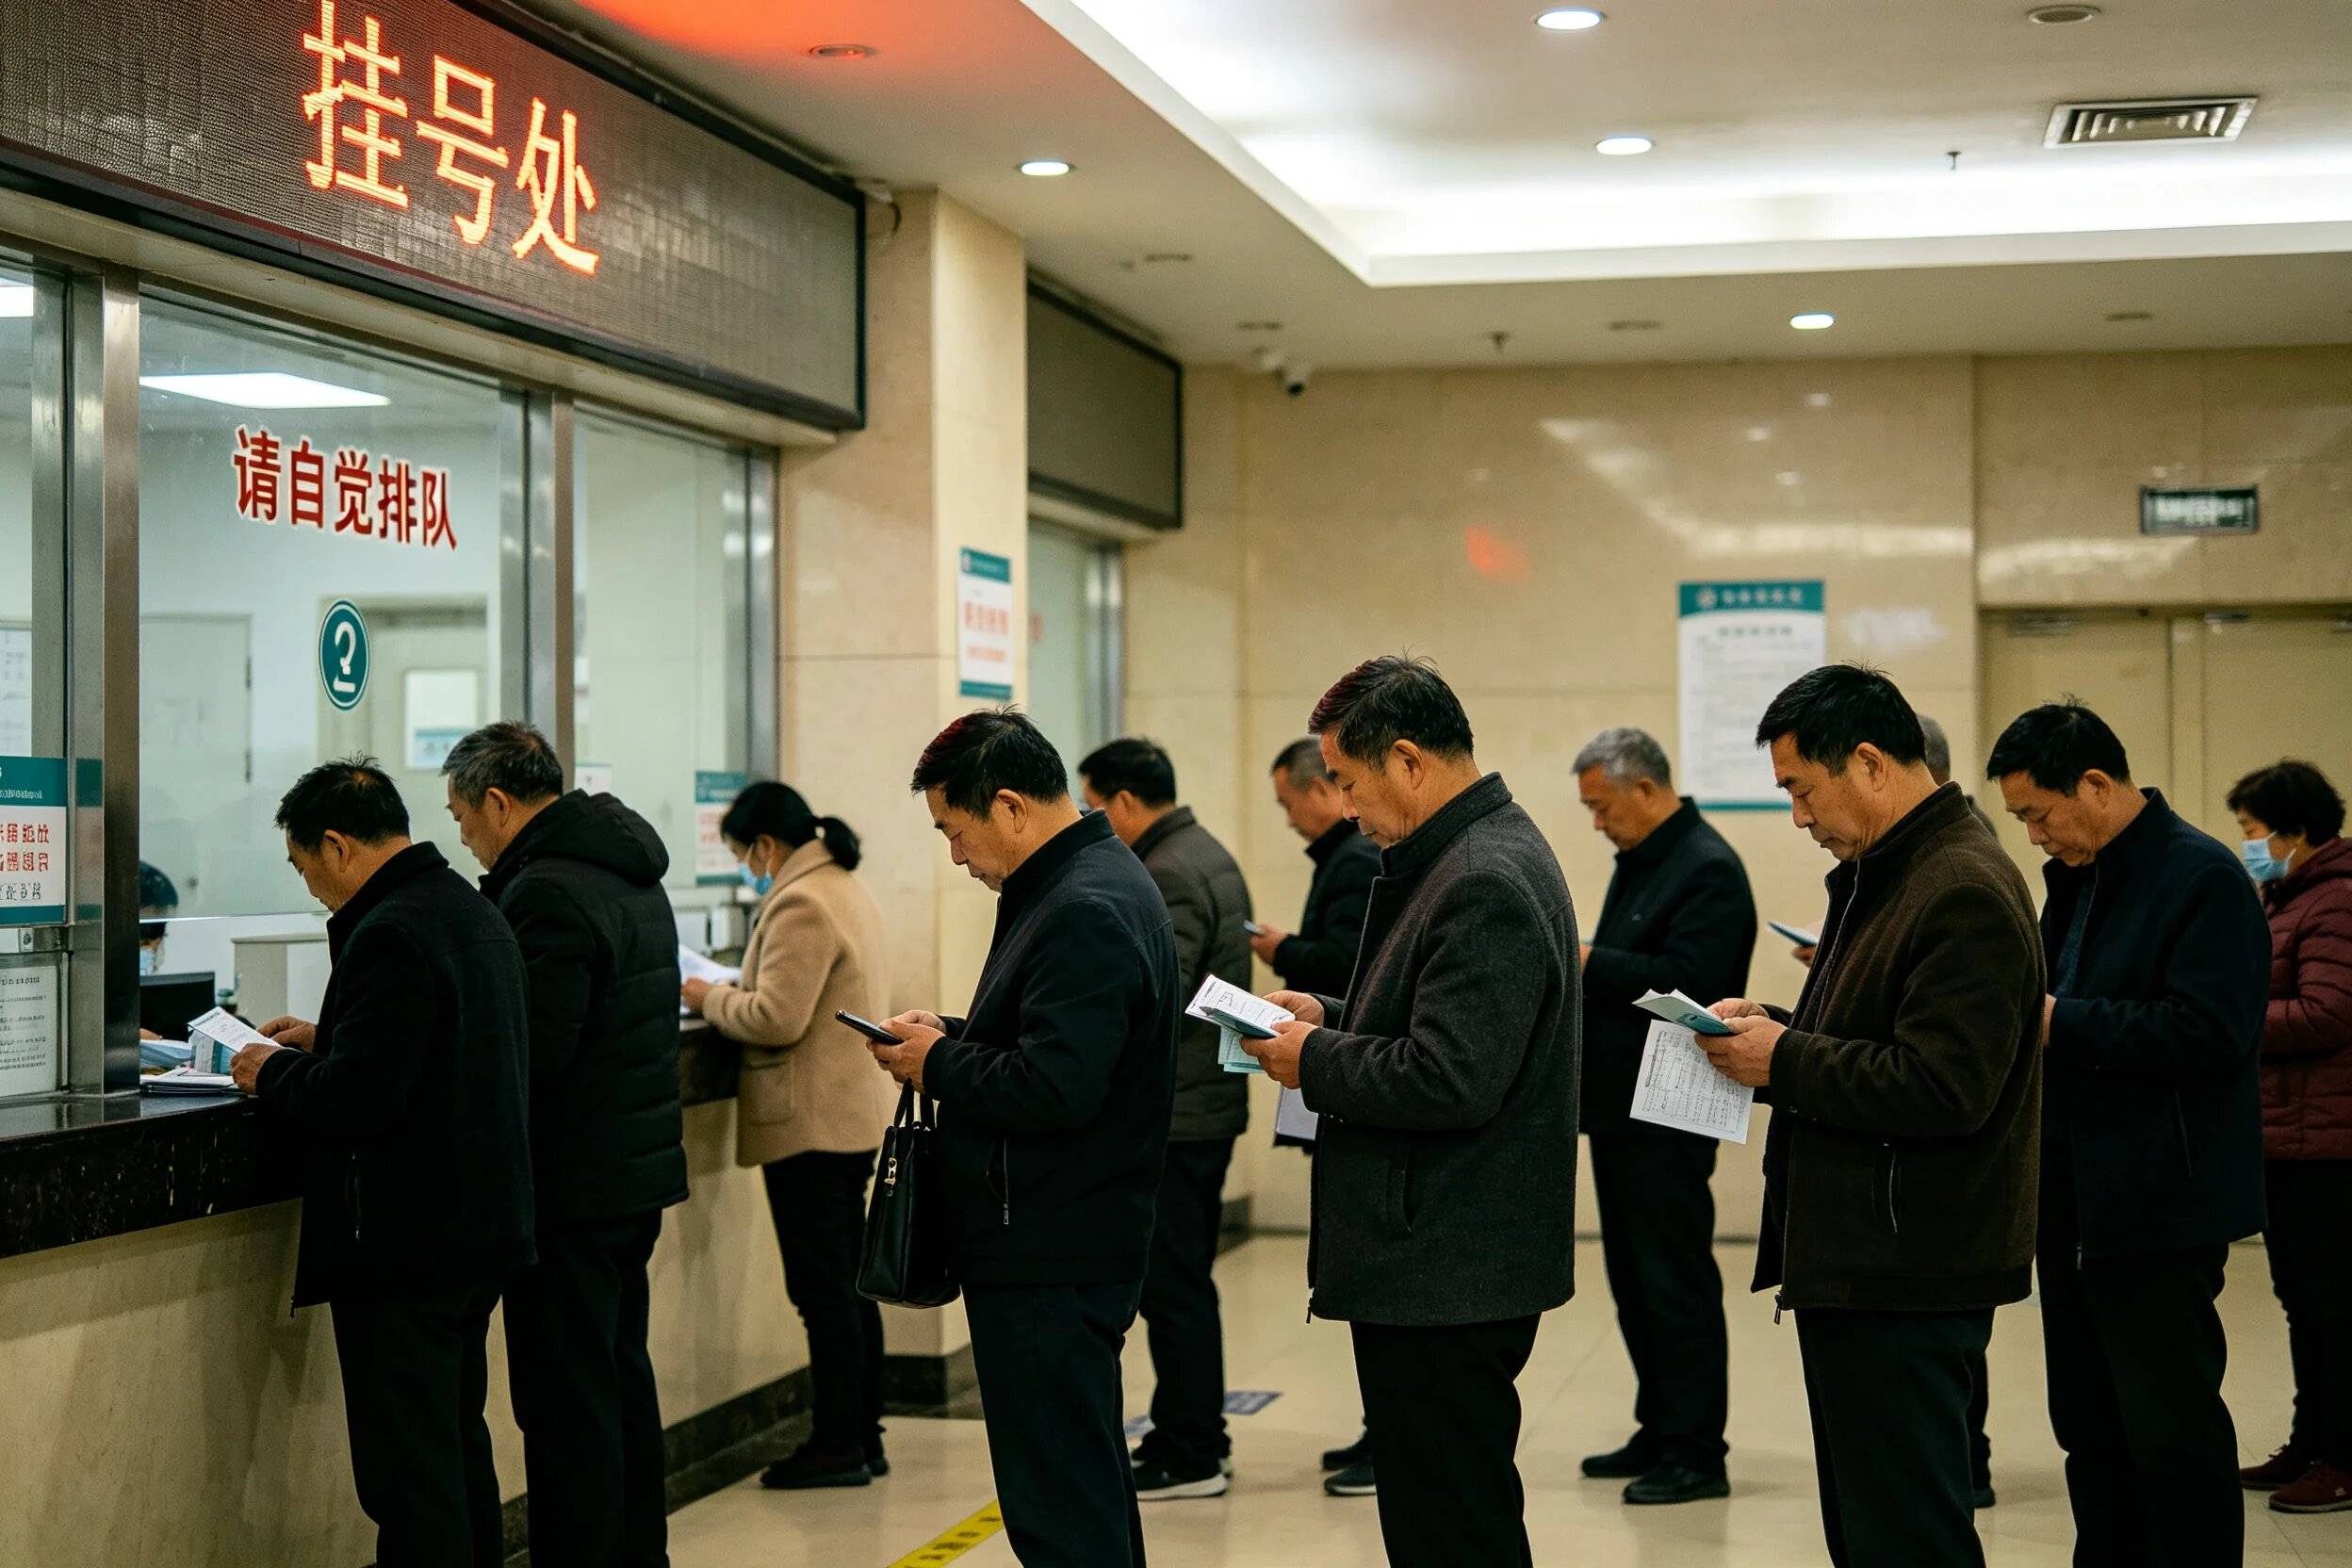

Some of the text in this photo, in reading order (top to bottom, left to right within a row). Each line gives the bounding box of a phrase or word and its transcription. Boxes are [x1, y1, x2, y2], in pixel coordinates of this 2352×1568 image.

[302, 0, 600, 274] 挂号处
[233, 426, 457, 550] 请自觉排队
